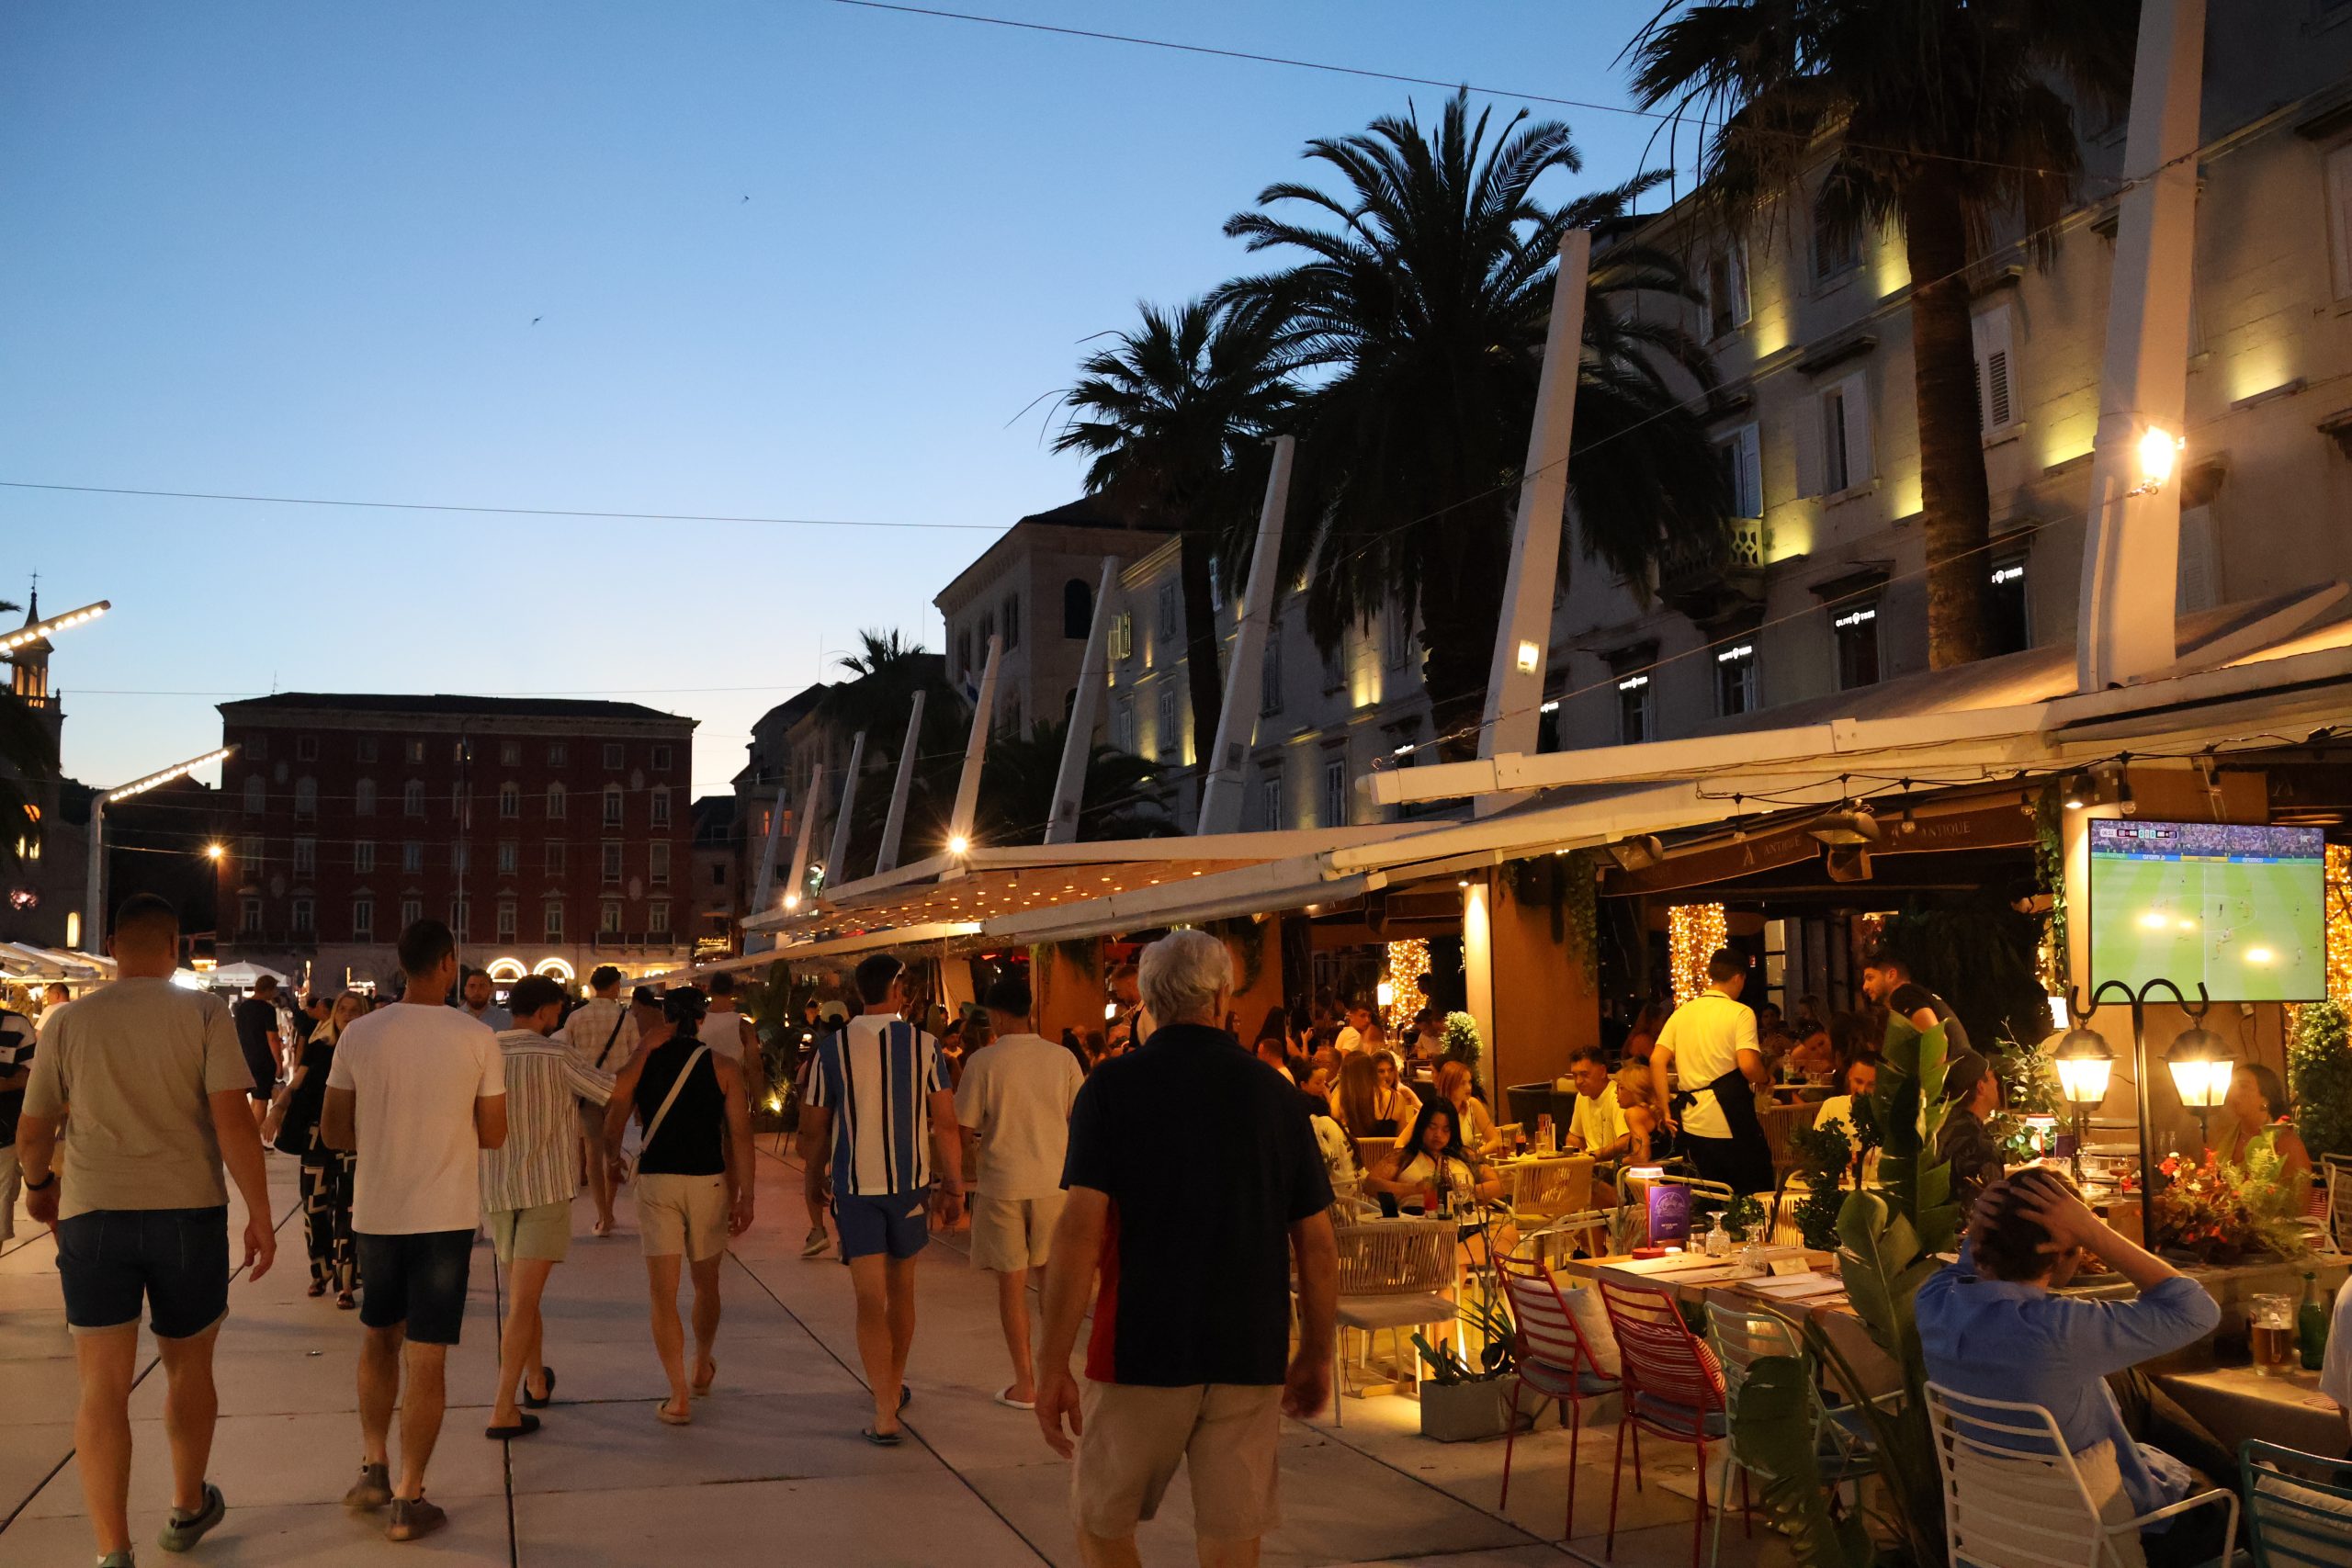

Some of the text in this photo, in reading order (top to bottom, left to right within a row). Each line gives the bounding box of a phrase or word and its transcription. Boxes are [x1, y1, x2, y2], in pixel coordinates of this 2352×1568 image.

[1836, 610, 1875, 627] OLIVE TREE
[1919, 820, 1971, 840] ANTIQUE
